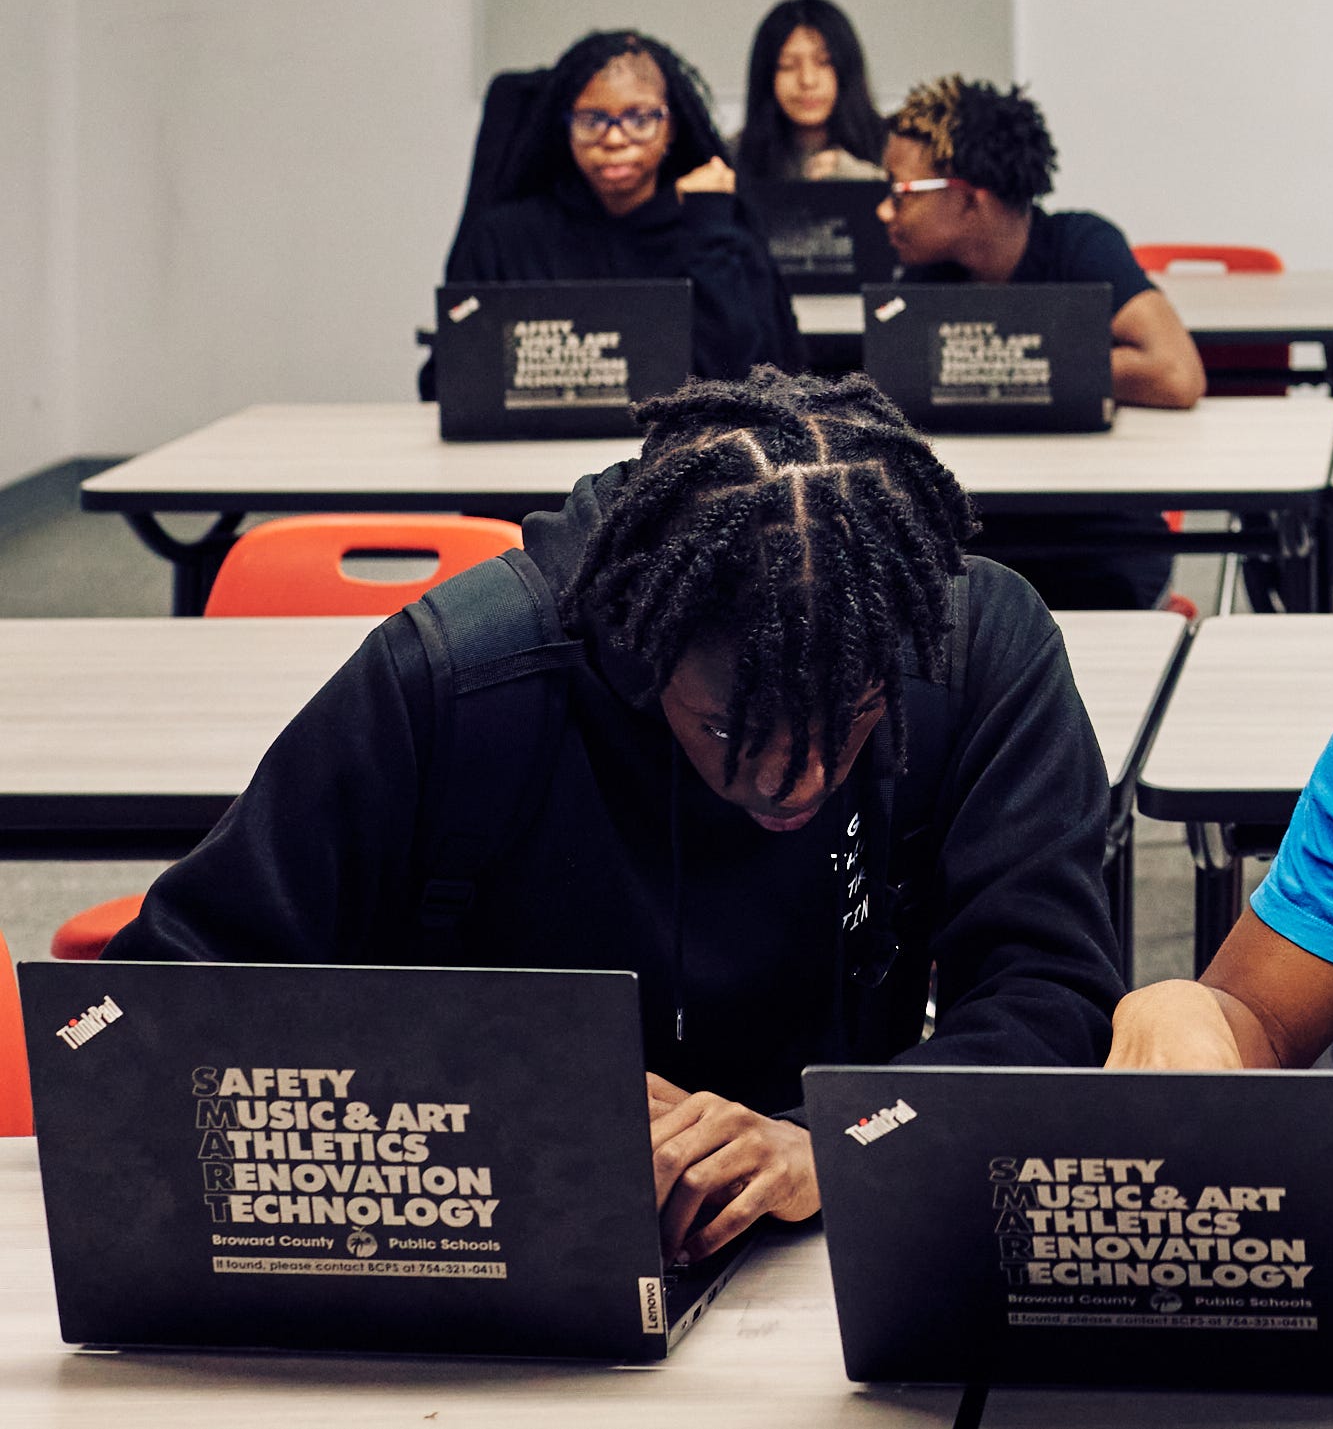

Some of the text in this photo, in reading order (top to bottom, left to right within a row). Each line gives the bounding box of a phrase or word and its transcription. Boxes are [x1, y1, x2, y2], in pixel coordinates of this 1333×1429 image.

[56, 995, 123, 1050] ThinkPad
[192, 1066, 356, 1098] SAFETY
[195, 1099, 471, 1133] MUSIC & ART
[197, 1129, 430, 1163] ATHLETICS
[202, 1161, 493, 1196] RENOVATION
[990, 1157, 1165, 1183] SAFETY
[204, 1193, 500, 1228] TECHNOLOGY
[993, 1183, 1287, 1211] MUSIC & ART
[212, 1234, 501, 1252] Broward County Public Schools
[1000, 1235, 1306, 1262] RENOVATION
[269, 1261, 312, 1272] please
[315, 1263, 365, 1273] contact
[368, 1262, 399, 1273] BCPS
[402, 1263, 416, 1273] at
[646, 1282, 659, 1329] Lenovo
[1008, 1293, 1073, 1304] Broward
[1079, 1294, 1137, 1307] County
[1249, 1297, 1312, 1308] Schools
